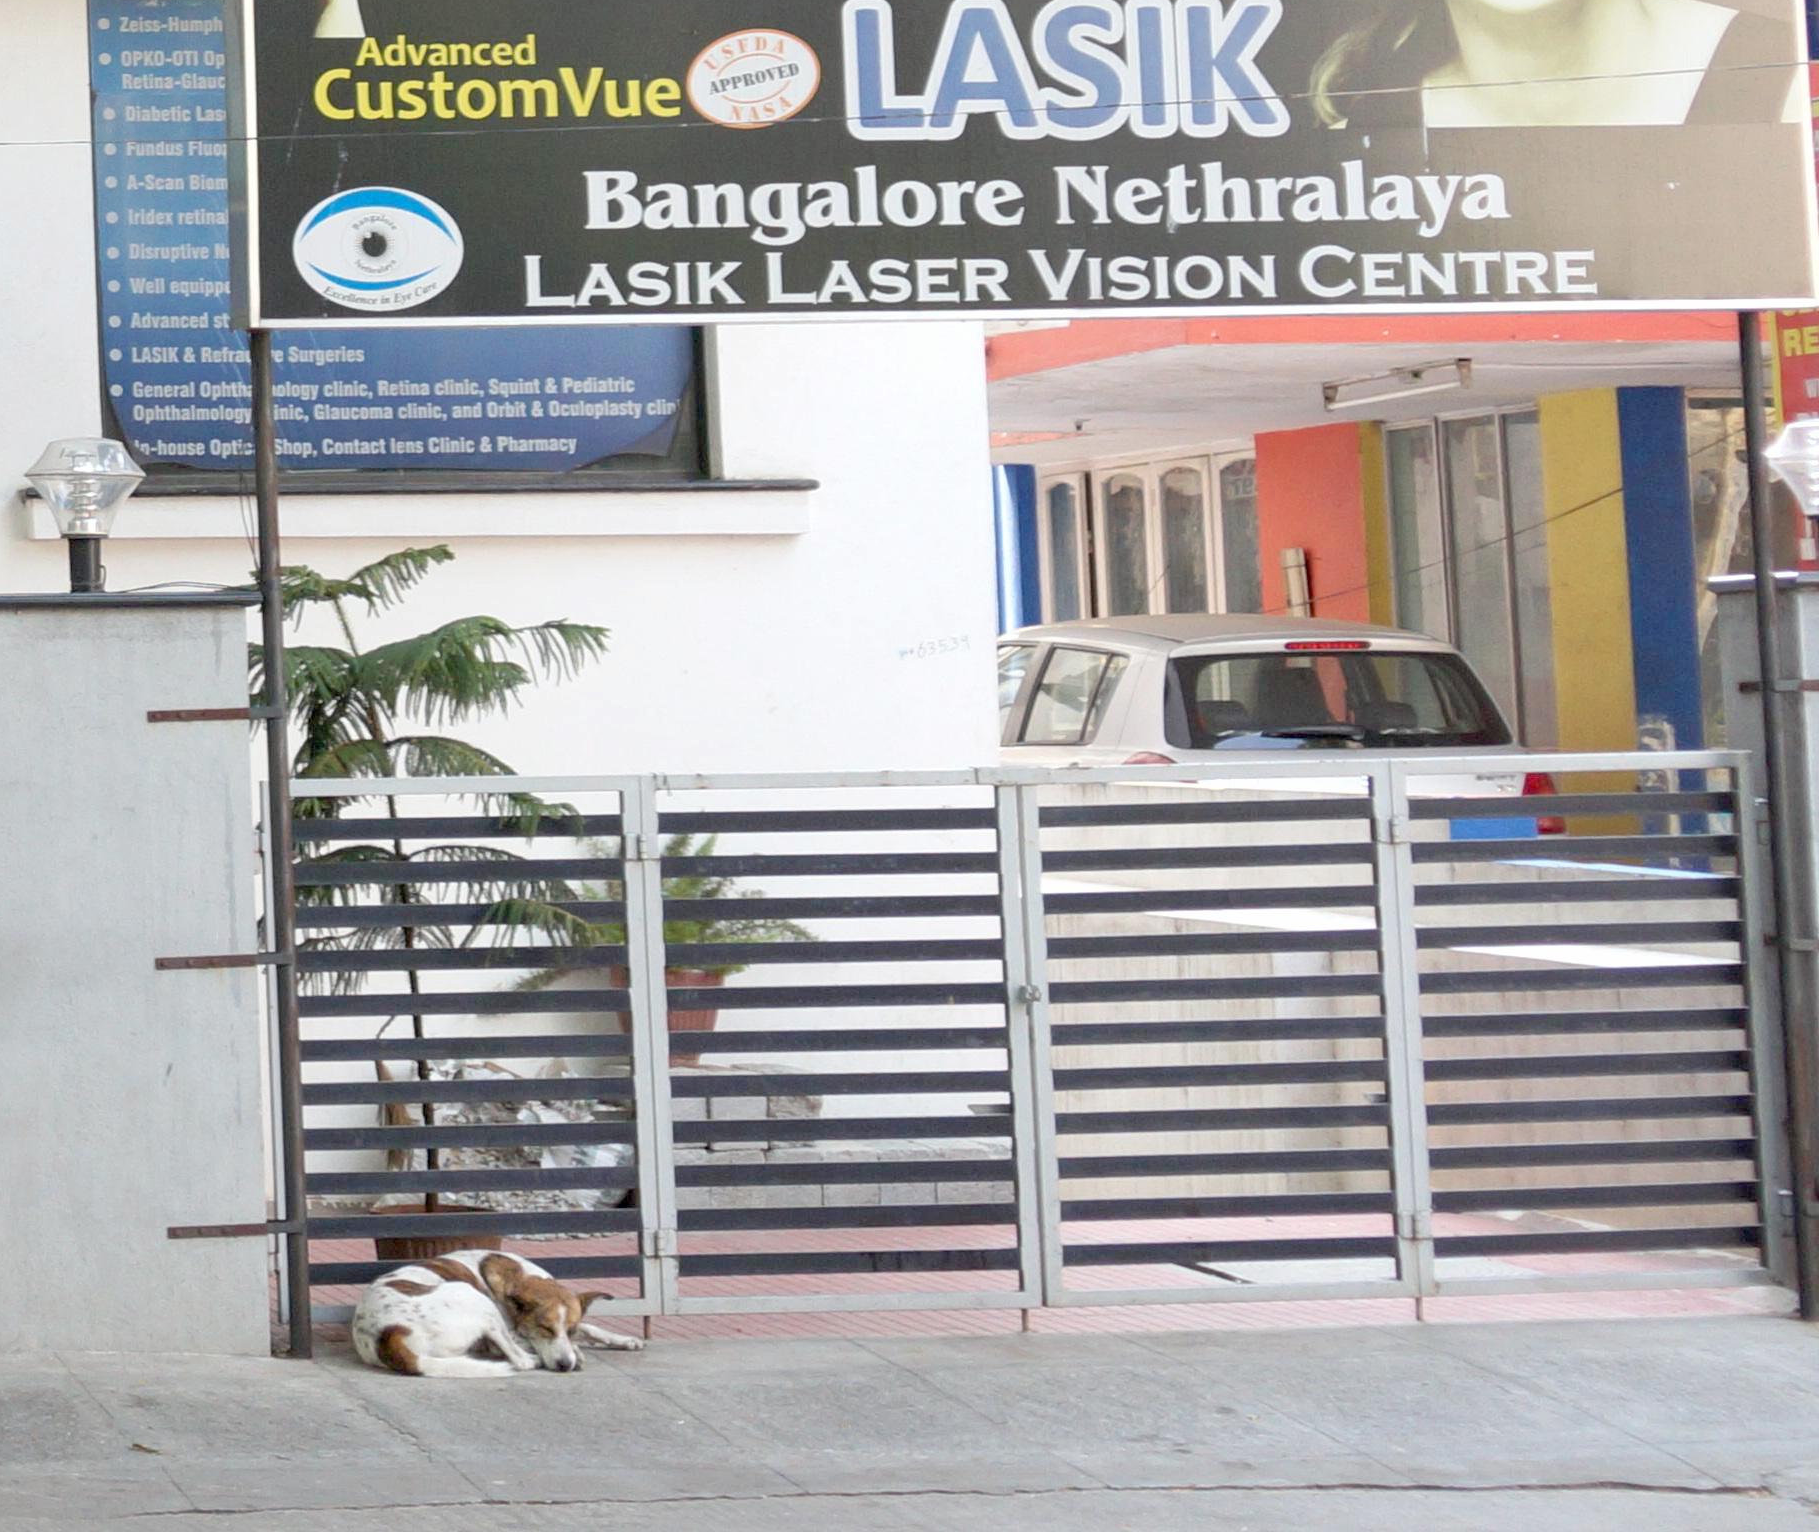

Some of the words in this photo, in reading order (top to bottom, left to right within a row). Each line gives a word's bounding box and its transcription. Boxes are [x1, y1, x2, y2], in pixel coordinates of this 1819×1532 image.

[121, 50, 199, 67] OPKO-OTI
[355, 34, 537, 69] Advanced
[708, 62, 800, 96] APPROVED
[314, 64, 682, 121] CustomVue
[124, 105, 192, 123] Diabetic
[126, 140, 184, 157] Fundus
[126, 174, 185, 191] A-Scan
[582, 168, 1026, 246] Bangalore
[1053, 159, 1513, 240] Nethralaya
[128, 209, 174, 226] Iridex
[128, 243, 210, 263] Disruptive
[128, 277, 165, 294] Well
[525, 254, 745, 308] LASIK
[767, 249, 1011, 306] LASER
[1028, 245, 1289, 303] VISION
[1299, 243, 1599, 300] CENTRE
[379, 295, 391, 305] in
[130, 312, 209, 329] Advanced
[131, 346, 179, 364] LASIK
[183, 346, 196, 363] &
[288, 345, 365, 366] Surgeries
[132, 380, 195, 399] General
[322, 378, 374, 399] clinic,
[376, 379, 431, 397] Retina
[433, 378, 485, 398] clinic,
[487, 377, 541, 398] Squint
[544, 377, 558, 394] &
[562, 376, 635, 394] Pediatric
[132, 403, 253, 424] Ophthalmology
[314, 403, 393, 421] Glaucoma
[397, 402, 448, 422] clinic,
[451, 402, 482, 419] and
[486, 400, 527, 418] Orbit
[531, 400, 544, 417] &
[548, 399, 642, 420] Oculoplasty
[273, 438, 318, 458] Shop,
[321, 437, 385, 456] Contact
[390, 437, 424, 454] lens
[427, 436, 476, 454] Clinic
[479, 436, 493, 454] &
[496, 435, 578, 455] Pharmacy
